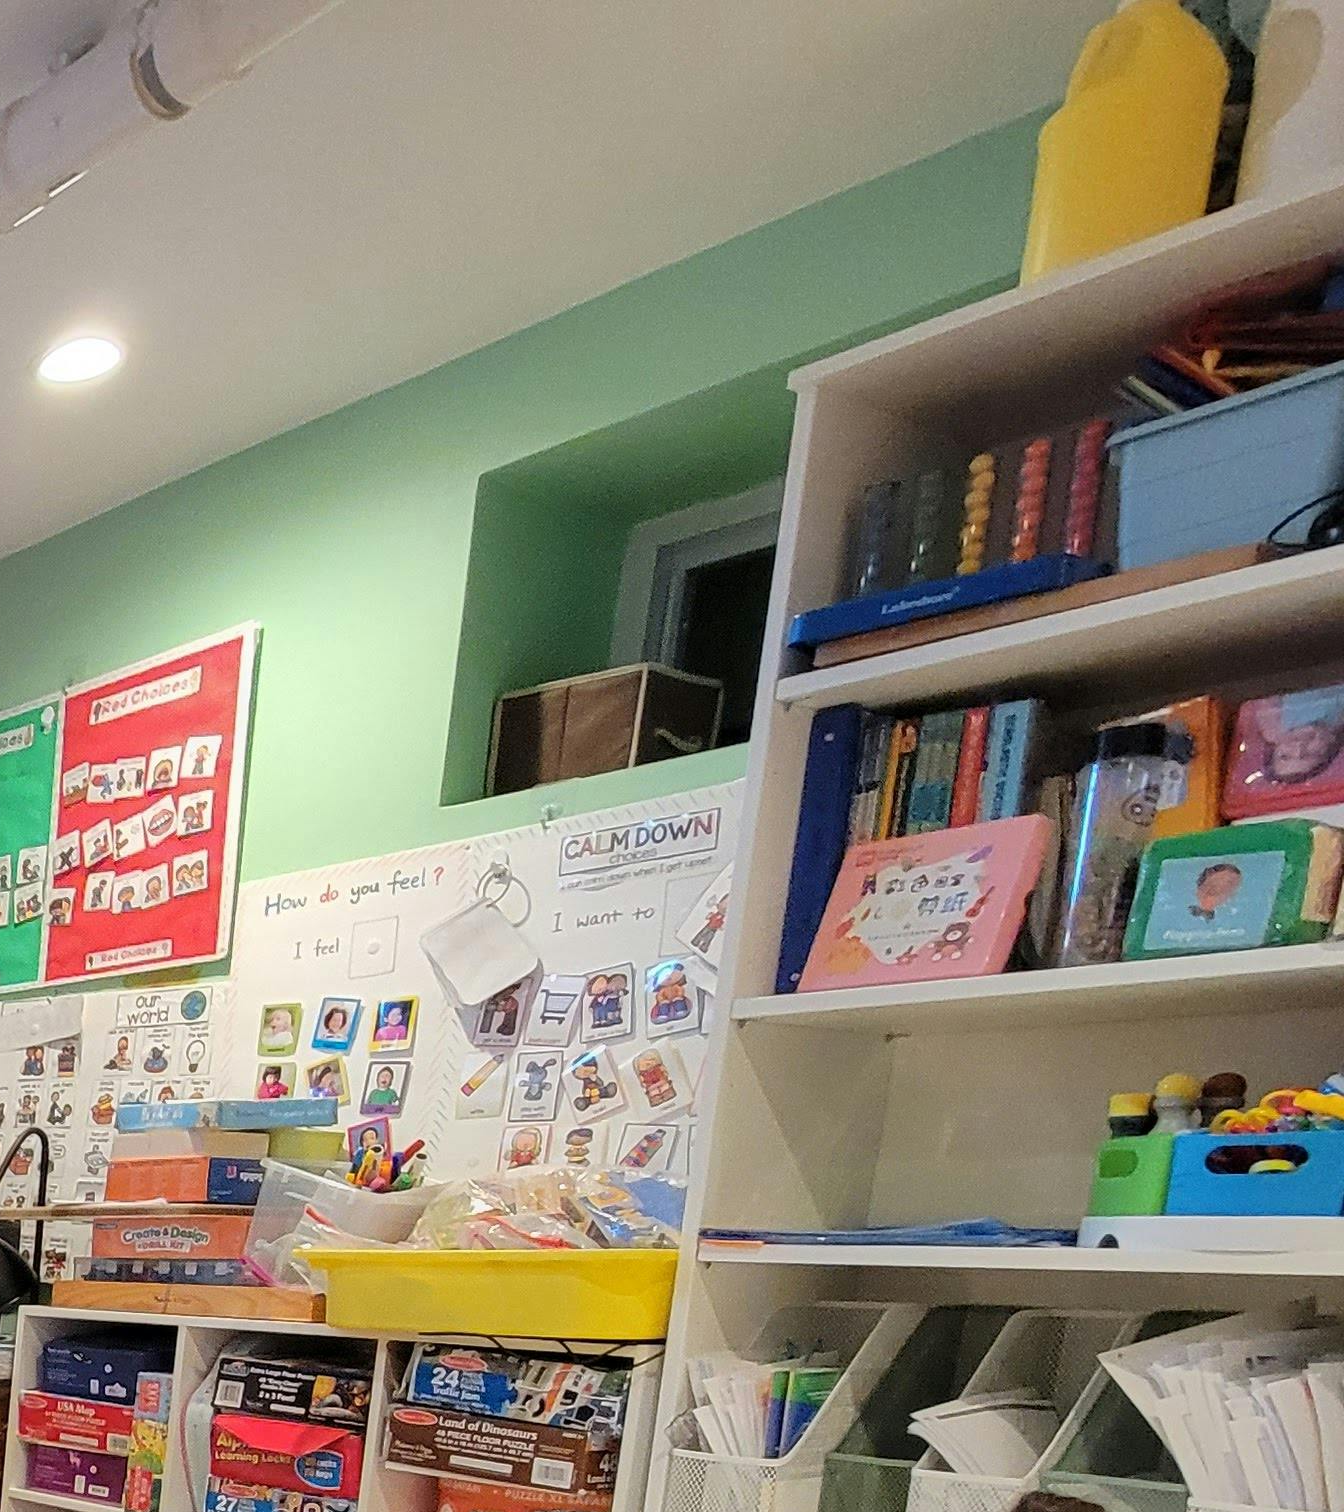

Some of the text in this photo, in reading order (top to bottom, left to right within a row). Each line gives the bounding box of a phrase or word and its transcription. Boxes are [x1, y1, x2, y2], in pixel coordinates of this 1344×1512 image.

[101, 678, 187, 716] Red Choices
[564, 813, 713, 860] CALM DOWN
[609, 848, 657, 864] choices
[633, 856, 712, 877] when get upset
[265, 867, 426, 917] How do you feel
[552, 907, 655, 933] I want to
[101, 946, 157, 963] Red Choices
[293, 938, 339, 960] I feel
[136, 995, 161, 1007] our
[127, 1006, 169, 1026] world
[123, 1226, 209, 1242] Create Design
[432, 1367, 460, 1387] 24
[433, 1385, 460, 1398] Traffic
[57, 1401, 96, 1416] USA Map
[438, 1417, 538, 1441] Land of Dinosaurs
[447, 1431, 472, 1442] PIECE
[473, 1434, 501, 1446] FLOOR
[502, 1438, 535, 1450] PUZZLE
[215, 1451, 258, 1464] Learning
[215, 1495, 237, 1512] 27
[505, 1489, 563, 1503] PUZZLE XL
